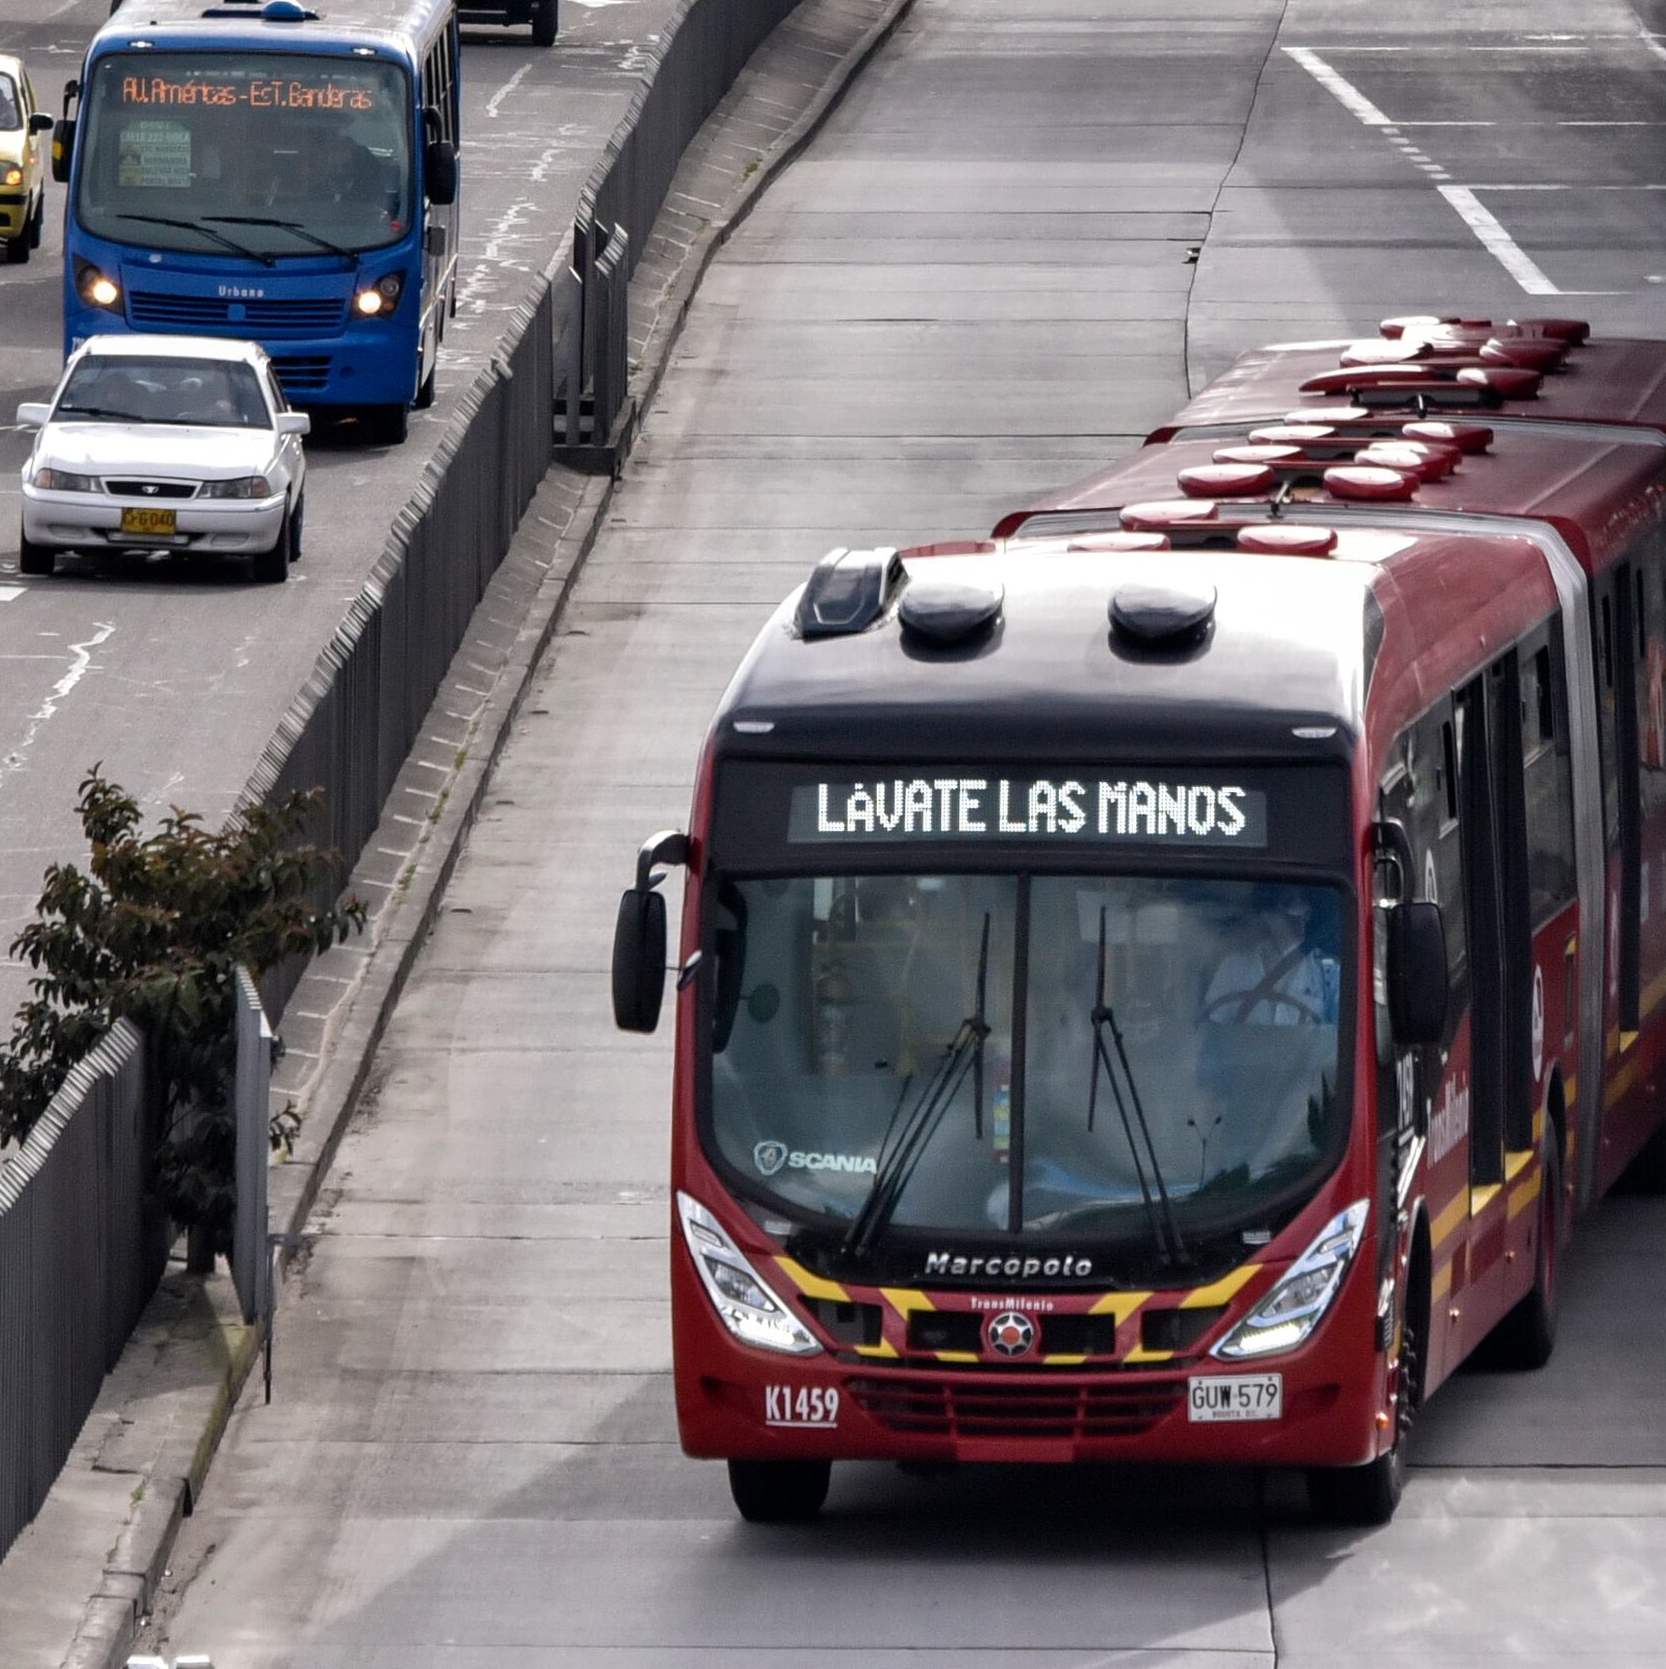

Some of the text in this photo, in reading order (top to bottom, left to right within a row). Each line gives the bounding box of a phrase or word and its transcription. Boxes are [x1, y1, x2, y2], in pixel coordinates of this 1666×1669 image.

[218, 285, 265, 298] Urbano
[999, 779, 1086, 833] LAS
[1098, 780, 1246, 836] MANOS
[788, 1151, 877, 1175] SCANIA
[924, 1251, 1093, 1278] Marcopolo
[970, 1296, 1054, 1312] TransMilenio
[765, 1385, 839, 1422] K1459
